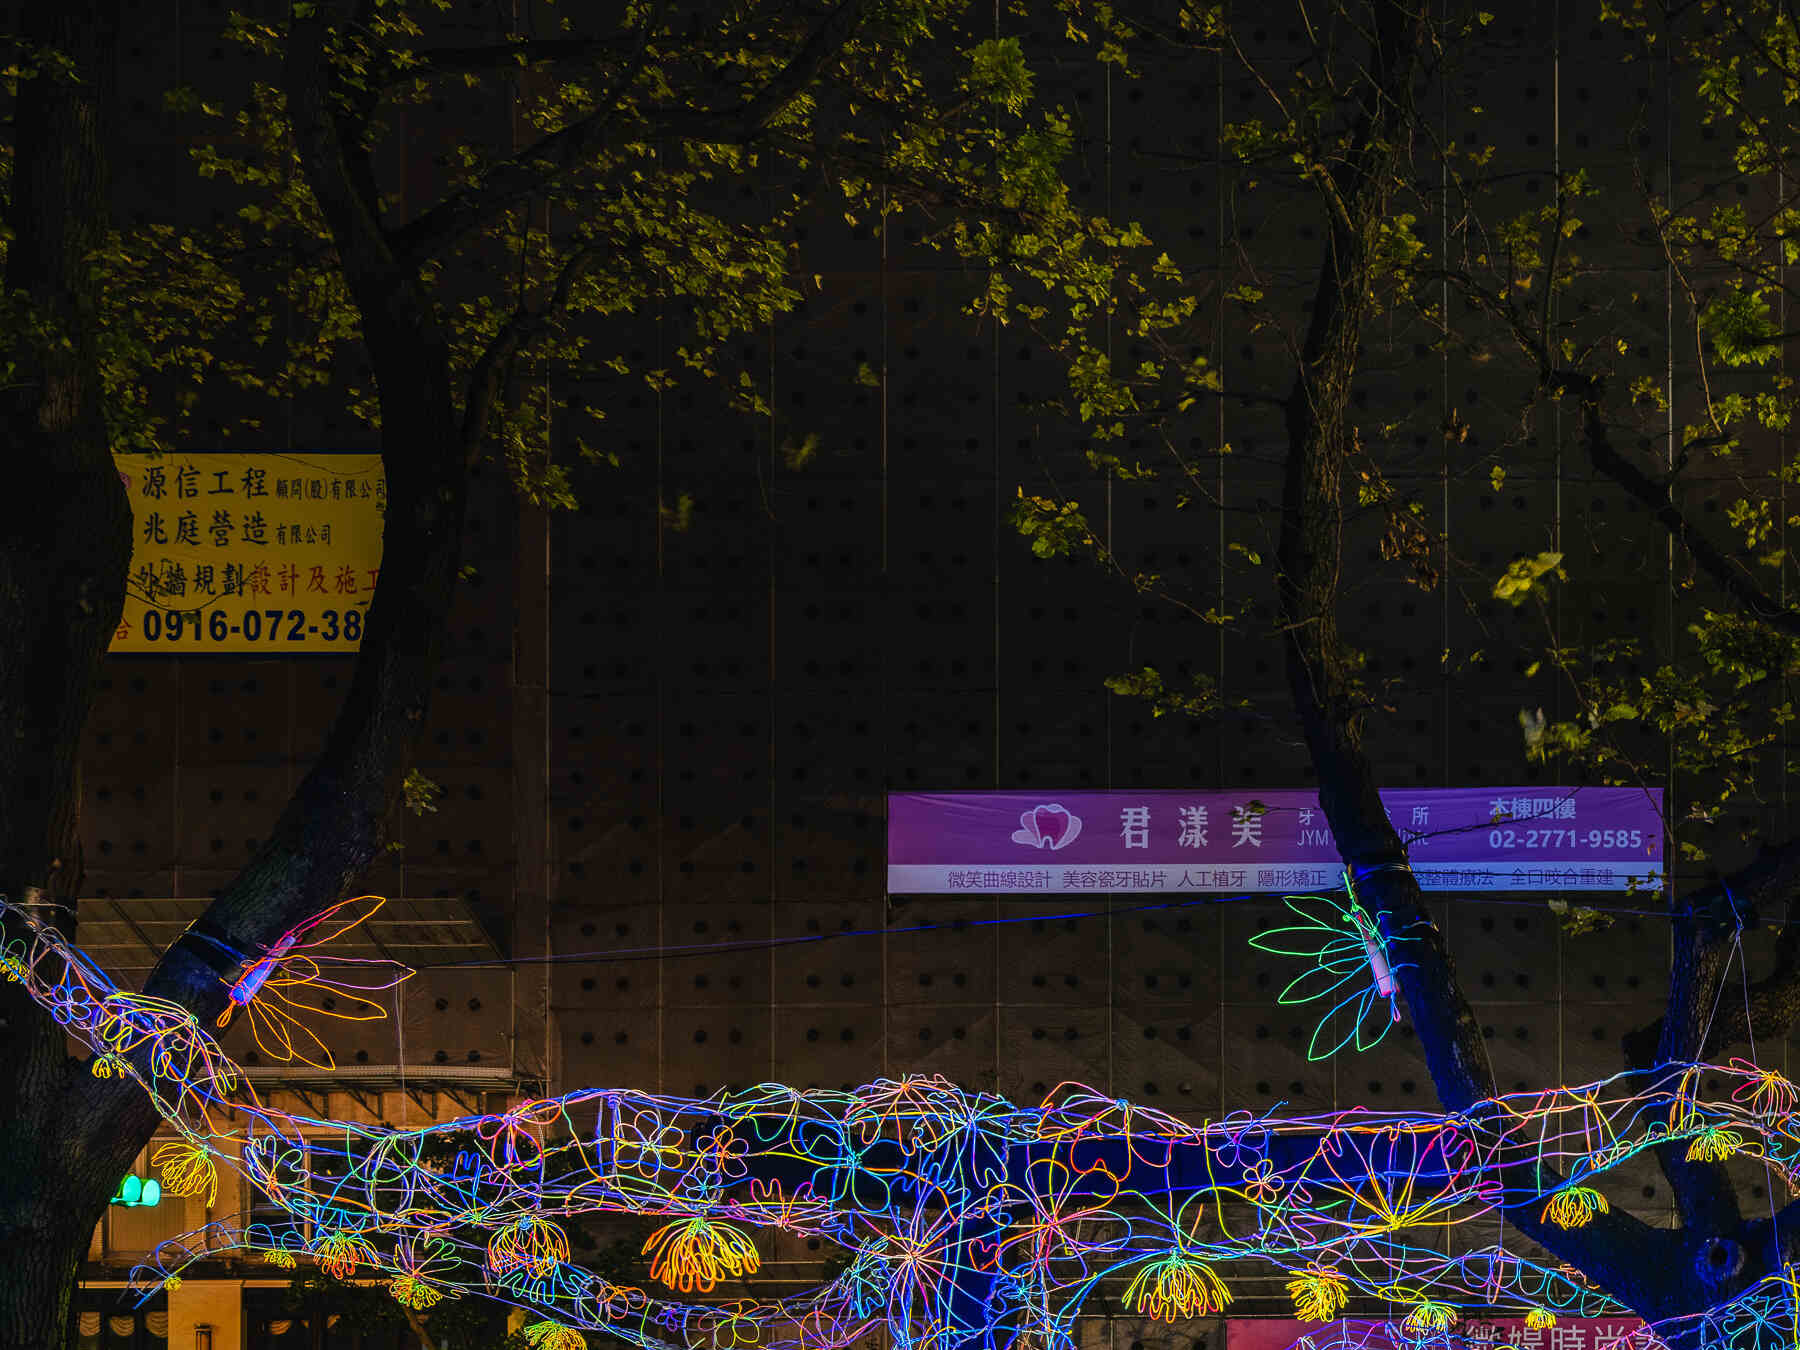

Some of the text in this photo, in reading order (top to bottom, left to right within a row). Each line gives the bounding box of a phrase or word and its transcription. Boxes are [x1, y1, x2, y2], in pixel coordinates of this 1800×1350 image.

[144, 610, 368, 641] 0916-072-38
[1297, 830, 1329, 847] JYM
[1489, 830, 1642, 848] 02-2771-9585
[947, 871, 1052, 889] 微笑曲線設計
[1063, 870, 1168, 889] 美容瓷牙貼片
[1177, 869, 1248, 888] 人工植牙
[1257, 869, 1329, 888] 隱形矯正
